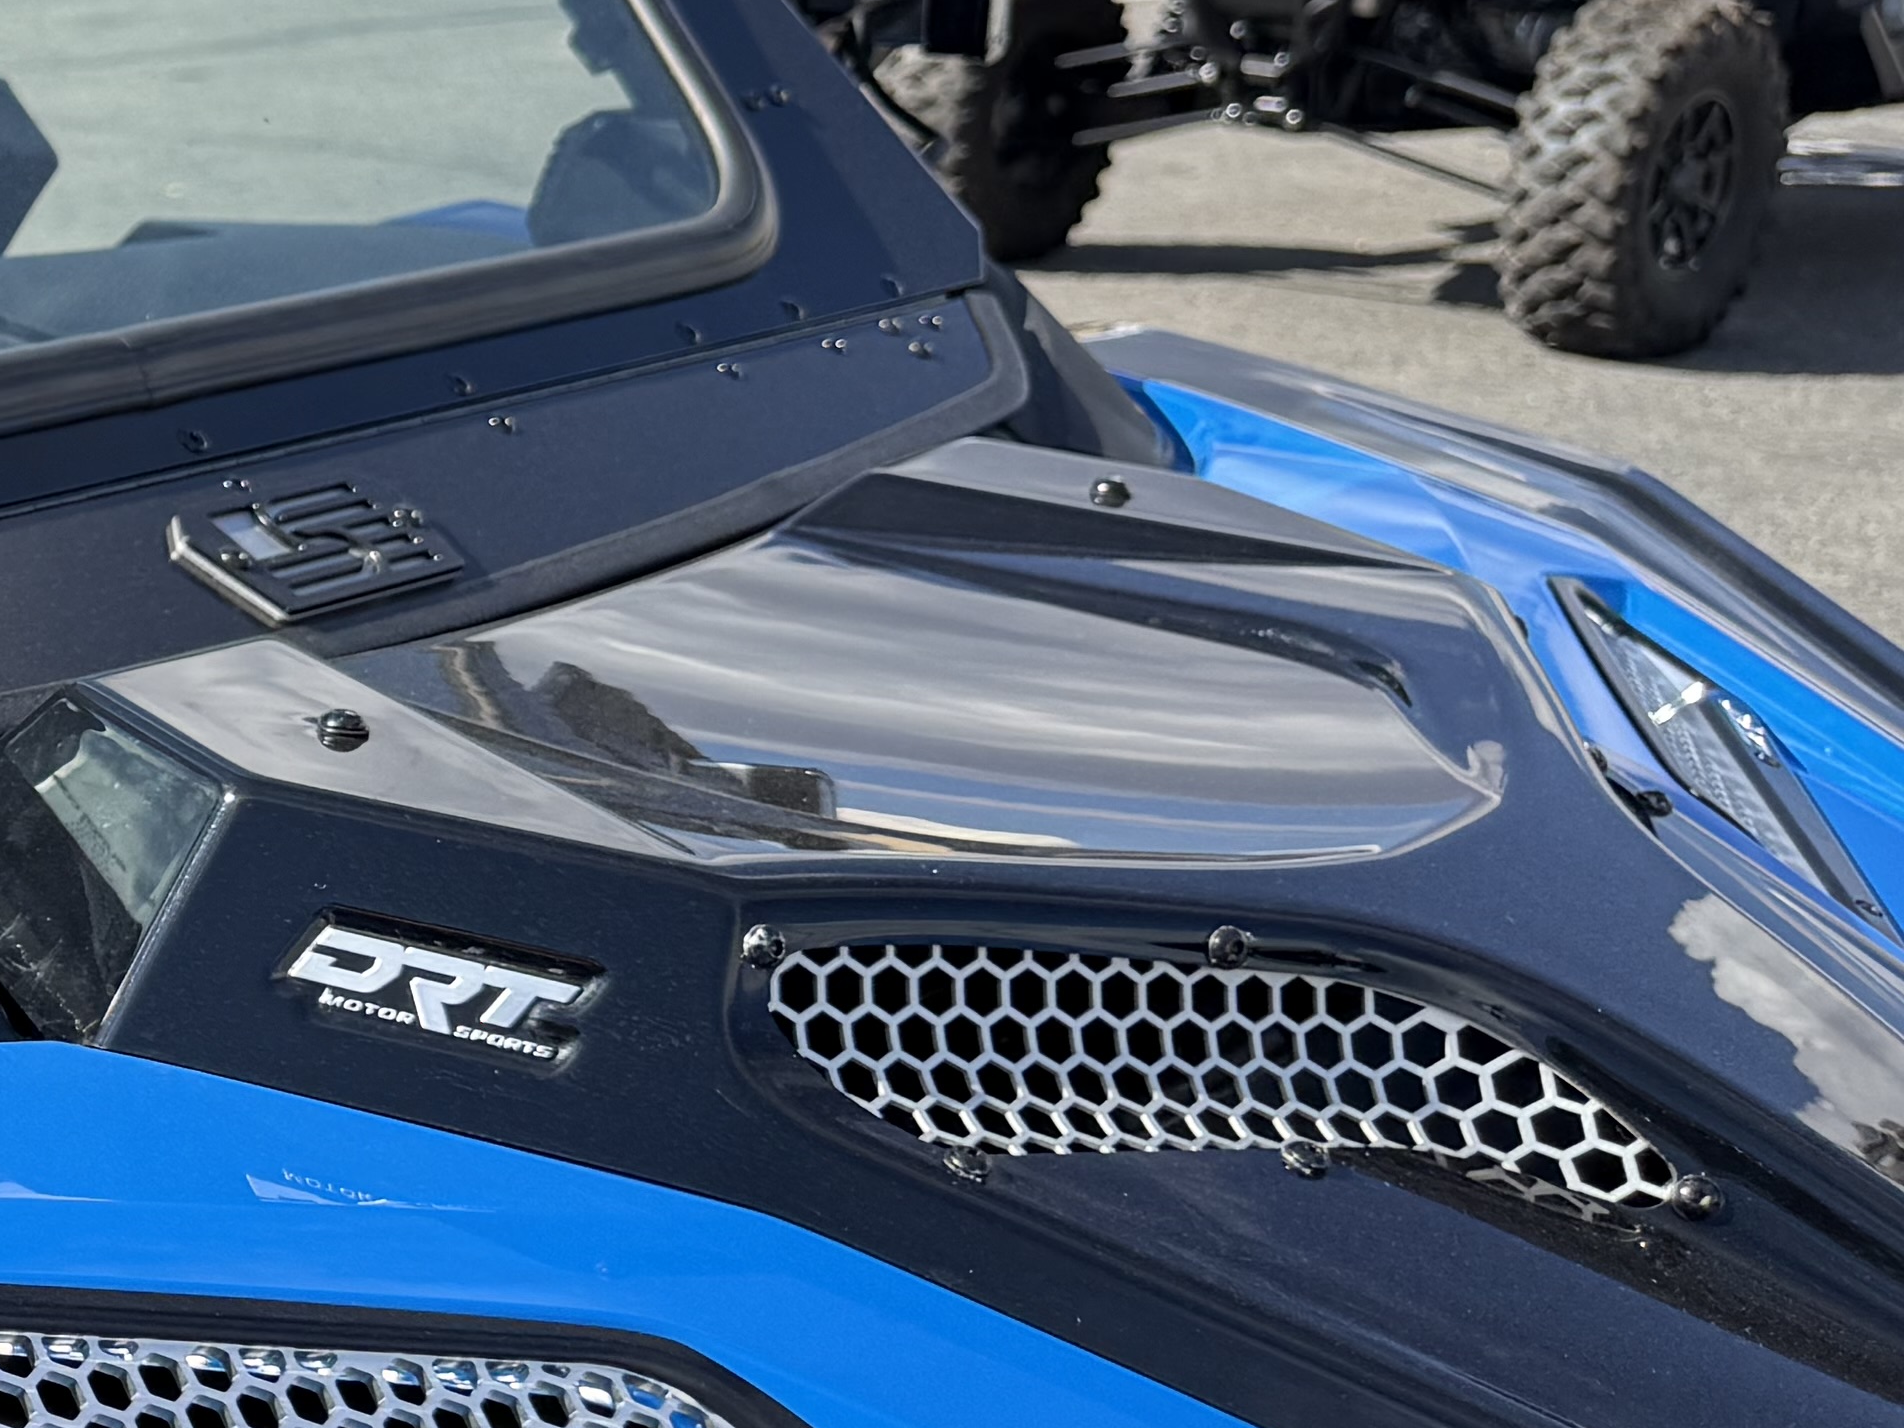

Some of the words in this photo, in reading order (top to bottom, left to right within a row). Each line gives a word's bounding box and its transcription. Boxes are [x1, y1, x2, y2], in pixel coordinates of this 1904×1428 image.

[287, 924, 585, 1035] DRT
[318, 987, 416, 1027] MOTOR
[452, 1023, 559, 1061] SPORTS
